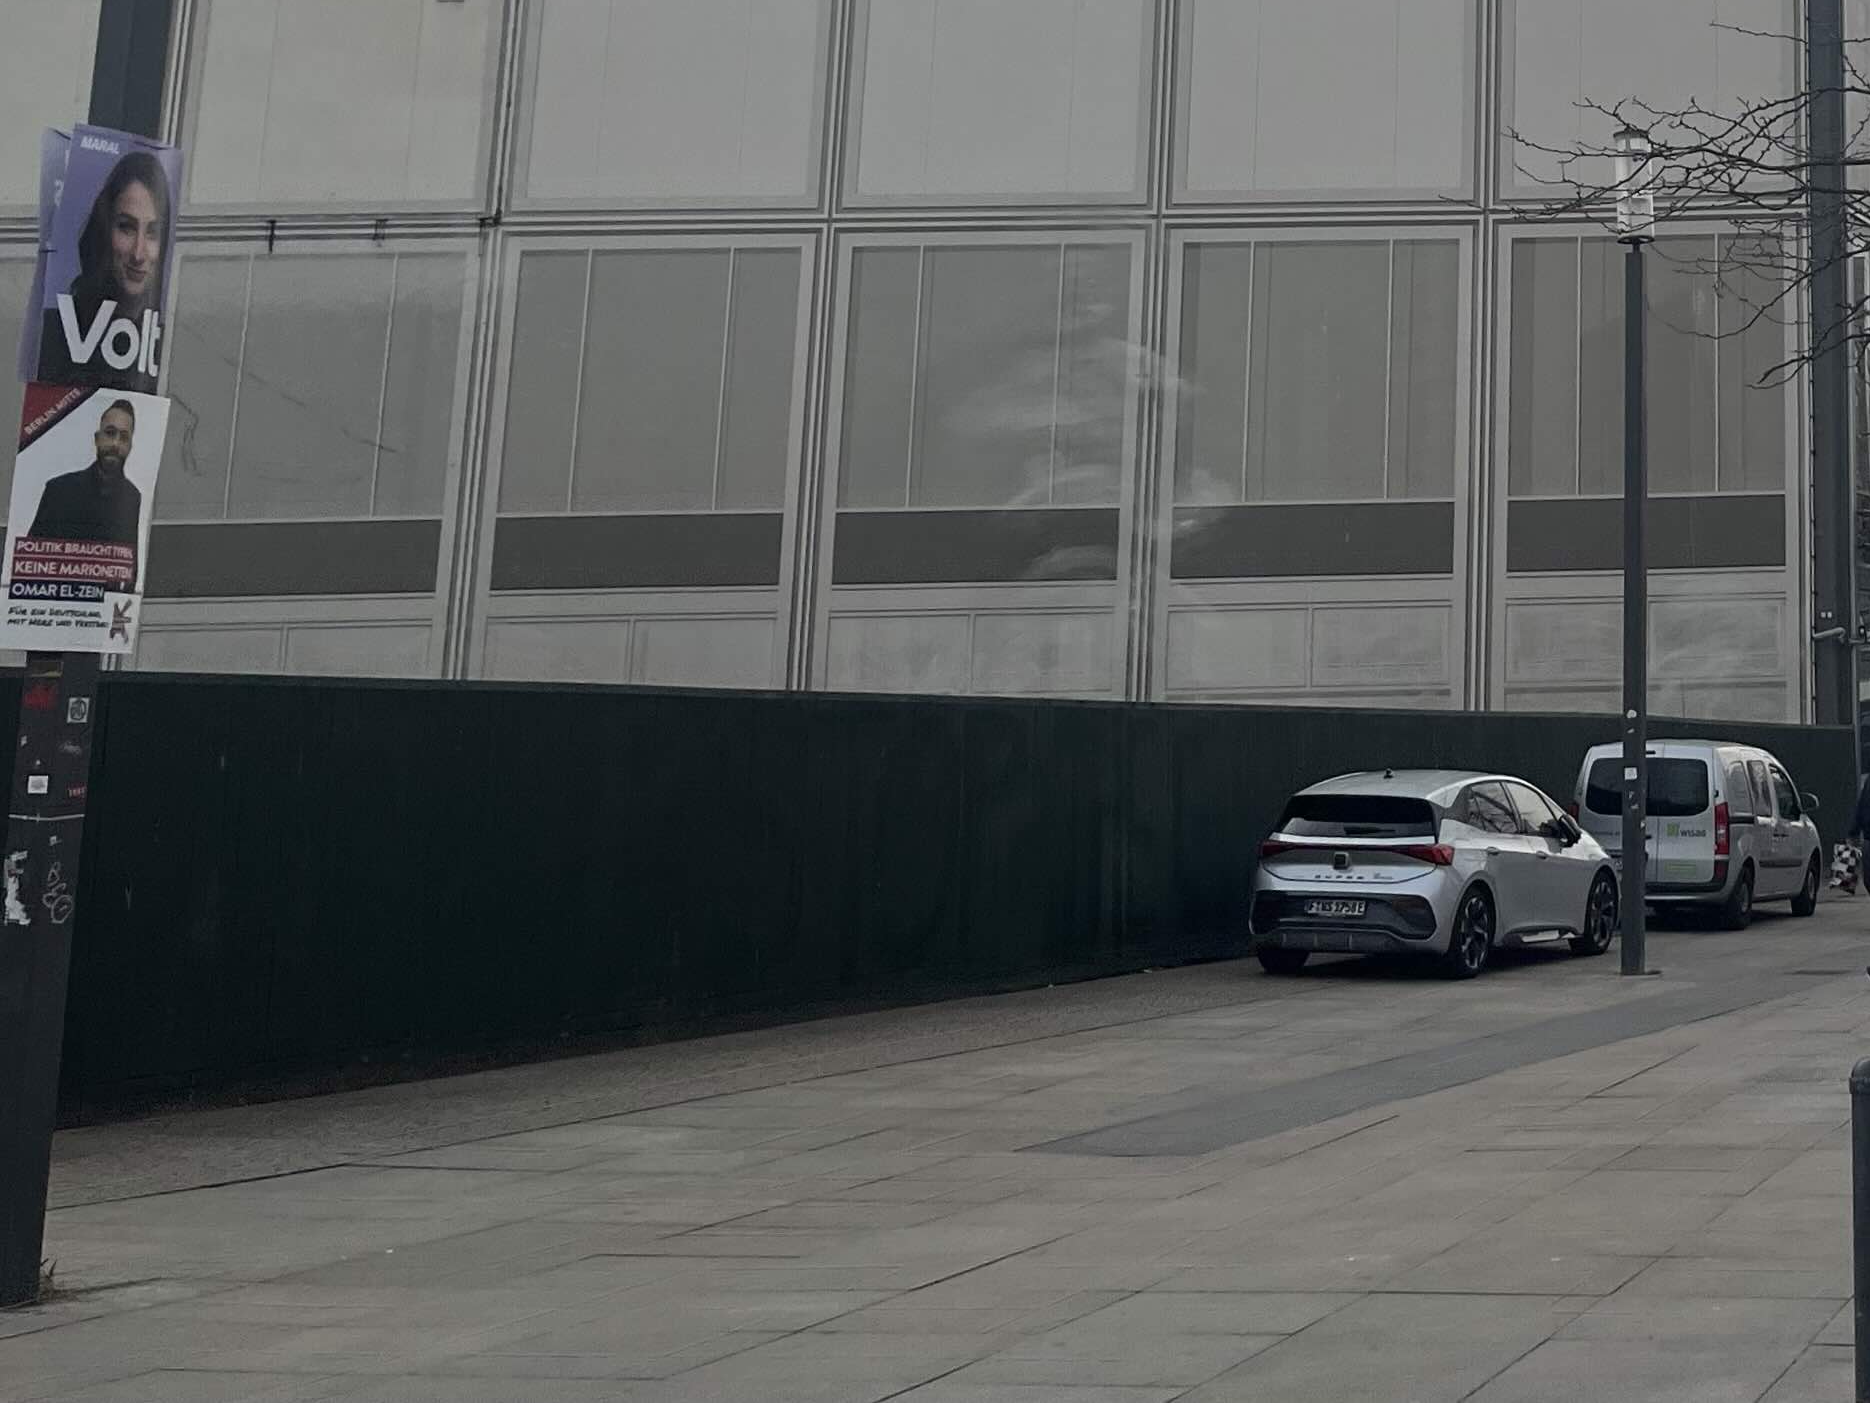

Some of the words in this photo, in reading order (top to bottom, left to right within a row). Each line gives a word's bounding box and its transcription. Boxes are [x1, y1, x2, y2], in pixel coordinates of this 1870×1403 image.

[80, 135, 120, 154] MARAL
[56, 293, 161, 377] Volt
[17, 541, 62, 552] POLITIK
[65, 543, 111, 555] BRAUCHT
[14, 561, 56, 574] KEINE
[12, 583, 57, 596] OMAR
[60, 584, 104, 598] EL-ZEIN
